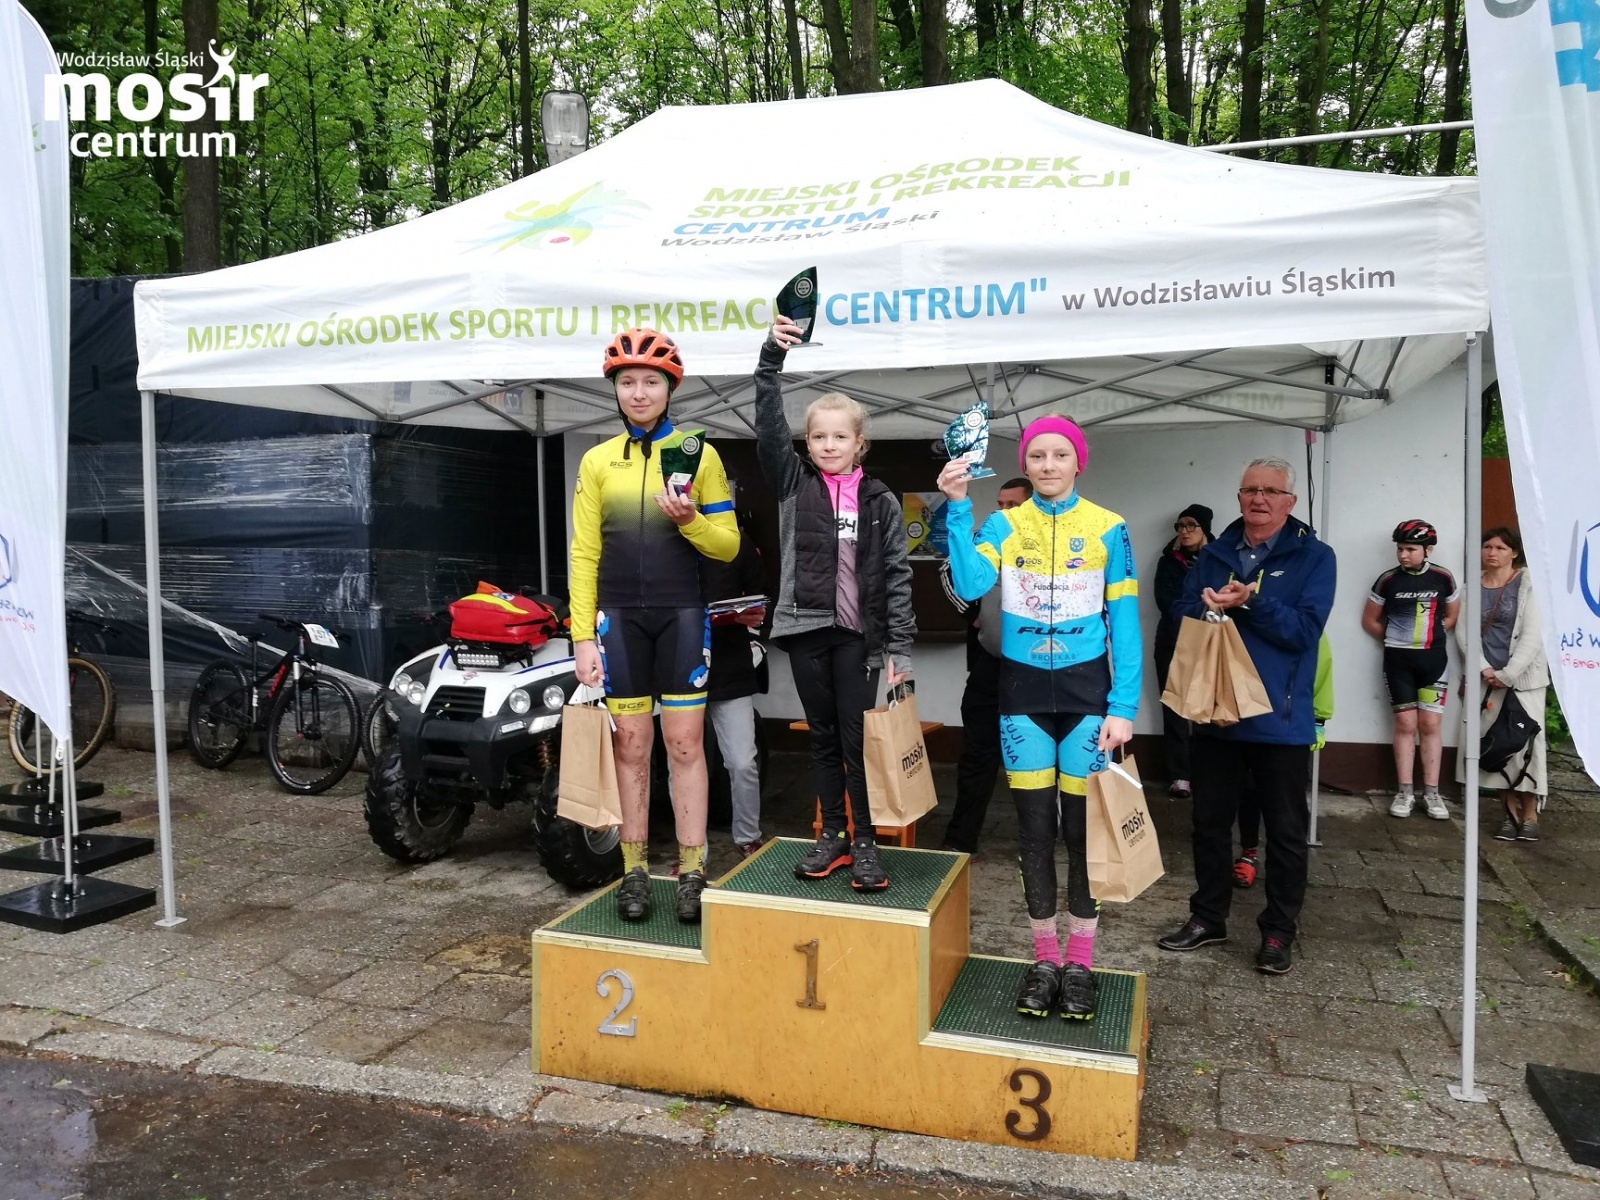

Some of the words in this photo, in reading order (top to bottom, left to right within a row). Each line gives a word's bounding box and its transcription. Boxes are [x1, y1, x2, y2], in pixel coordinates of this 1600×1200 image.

[687, 196, 857, 219] SPORTU
[867, 192, 882, 207] I
[892, 169, 1130, 201] REKREACJI
[703, 180, 860, 202] MIEJSKI
[870, 155, 1082, 190] OŚRODEK
[661, 230, 833, 248] Wodzisław
[841, 210, 941, 235] Śląski
[673, 206, 891, 235] CENTRUM
[187, 322, 291, 353] MIEJSKI
[295, 311, 441, 347] OŚRODEK
[449, 305, 579, 341] SPORTU
[590, 304, 600, 335] I
[611, 296, 780, 335] REKREAC
[1062, 292, 1086, 311] w
[1094, 275, 1272, 309] Wodzisławiu
[1281, 266, 1396, 297] Śląskim
[1017, 626, 1086, 635] FUJI
[794, 938, 827, 1011] 1
[596, 968, 638, 1038] 2
[1005, 1067, 1052, 1141] 3
